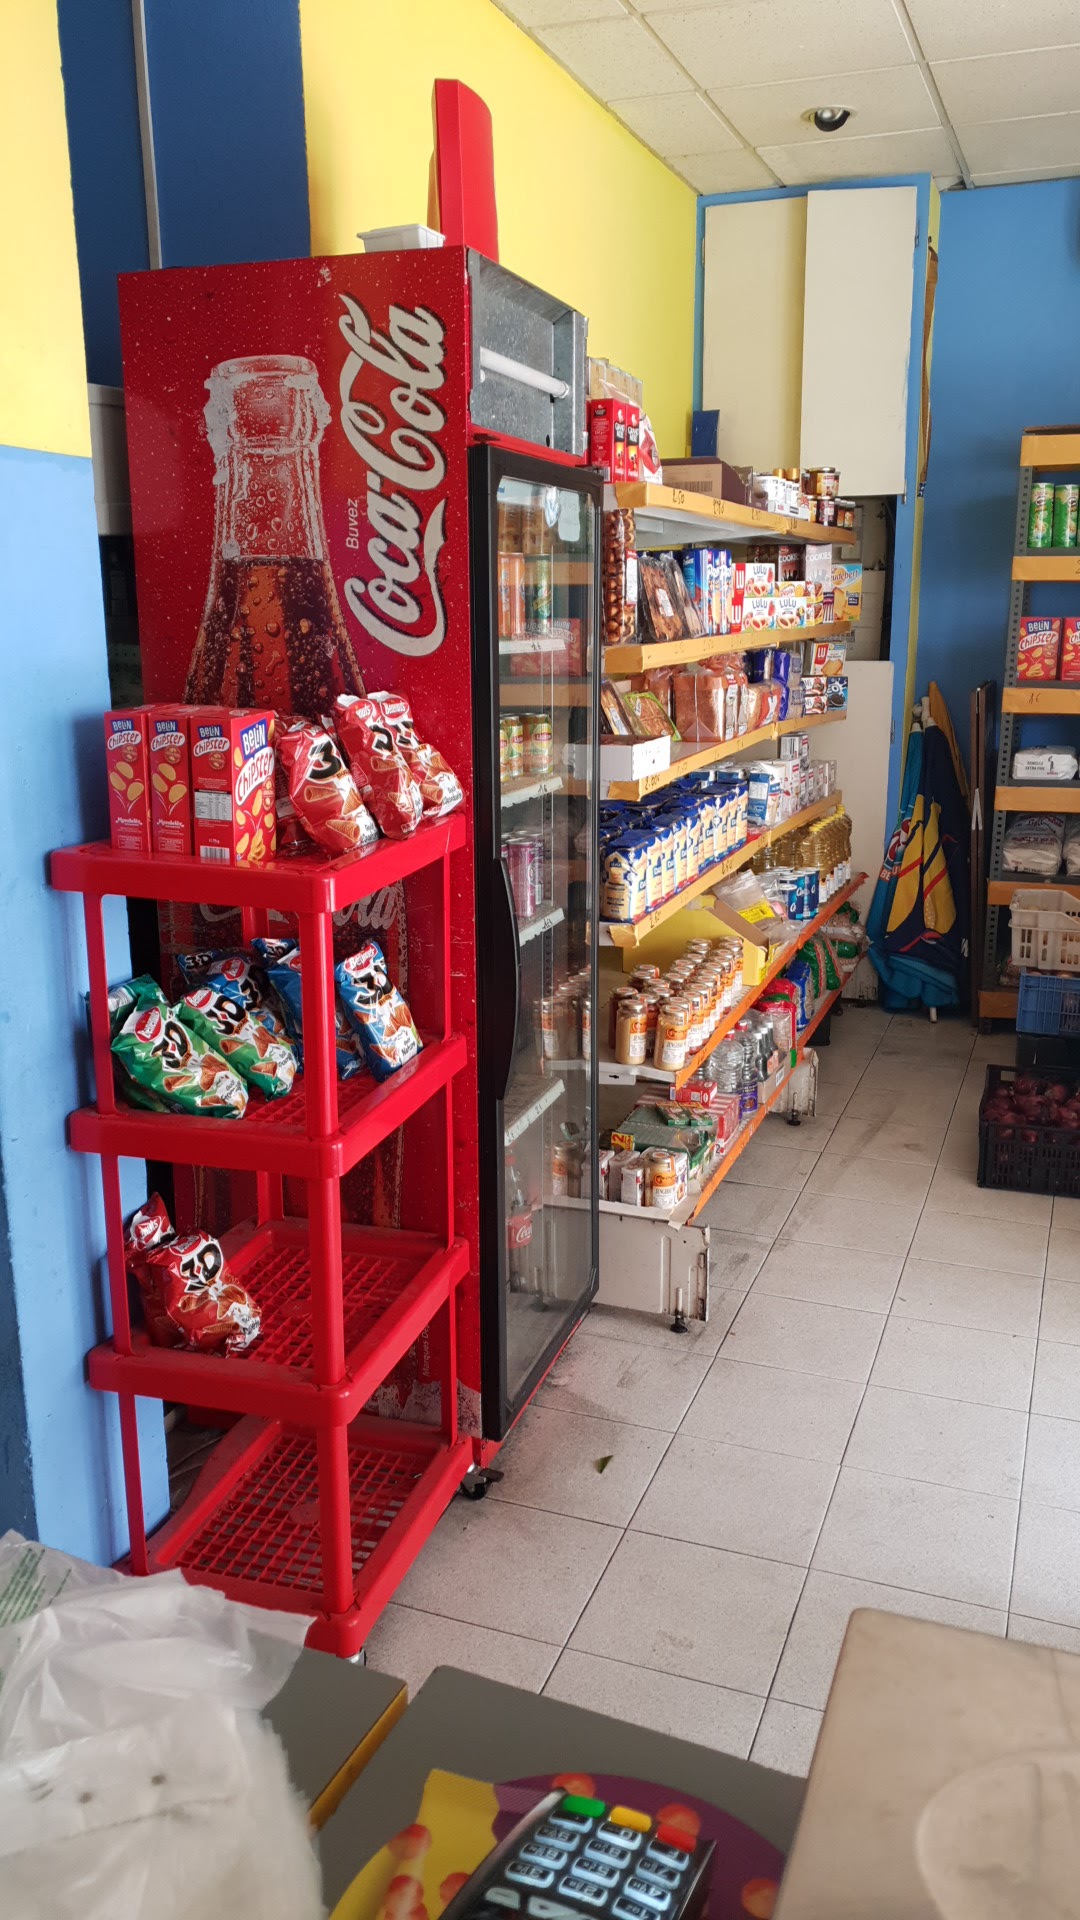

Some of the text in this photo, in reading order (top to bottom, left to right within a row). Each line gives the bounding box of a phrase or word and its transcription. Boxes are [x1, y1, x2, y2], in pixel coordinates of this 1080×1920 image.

[338, 292, 448, 657] Coca-Cola
[345, 498, 359, 549] Buvez
[806, 551, 832, 562] COOKIES
[752, 565, 767, 575] LULU
[736, 570, 745, 590] LU
[732, 604, 742, 624] LU
[1020, 633, 1057, 650] Chipster
[817, 647, 826, 658] LU
[108, 732, 141, 749] Chipster
[152, 733, 184, 750] Chipster
[194, 739, 229, 756] Chipster
[236, 752, 273, 803] Chipster
[206, 995, 247, 1036] 3D
